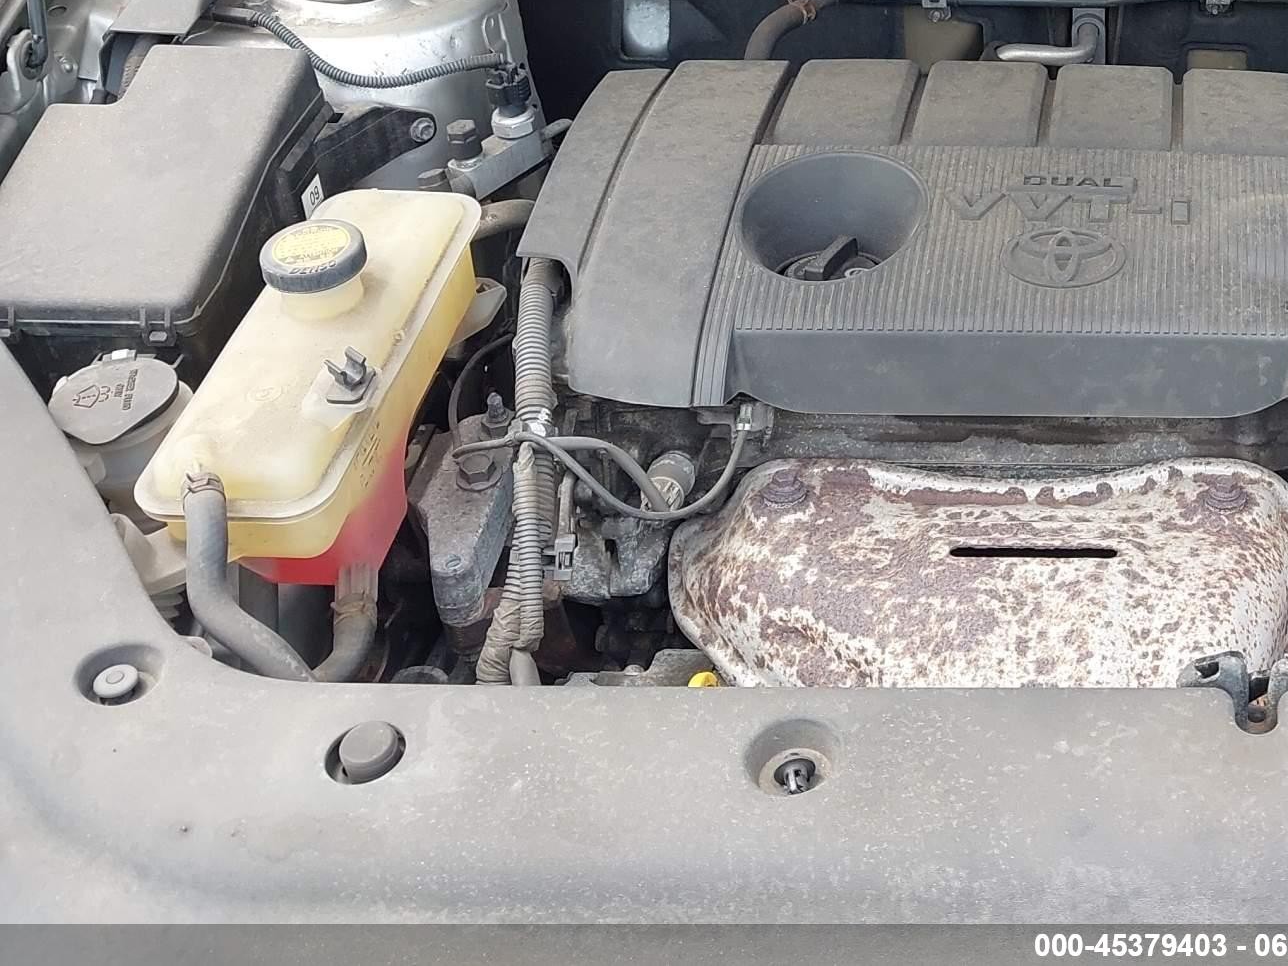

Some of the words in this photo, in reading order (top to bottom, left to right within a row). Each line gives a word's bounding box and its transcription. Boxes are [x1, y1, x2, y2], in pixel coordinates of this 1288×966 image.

[1023, 175, 1123, 187] DUAL
[944, 190, 1191, 226] VVT-i
[289, 260, 336, 275] DENSO
